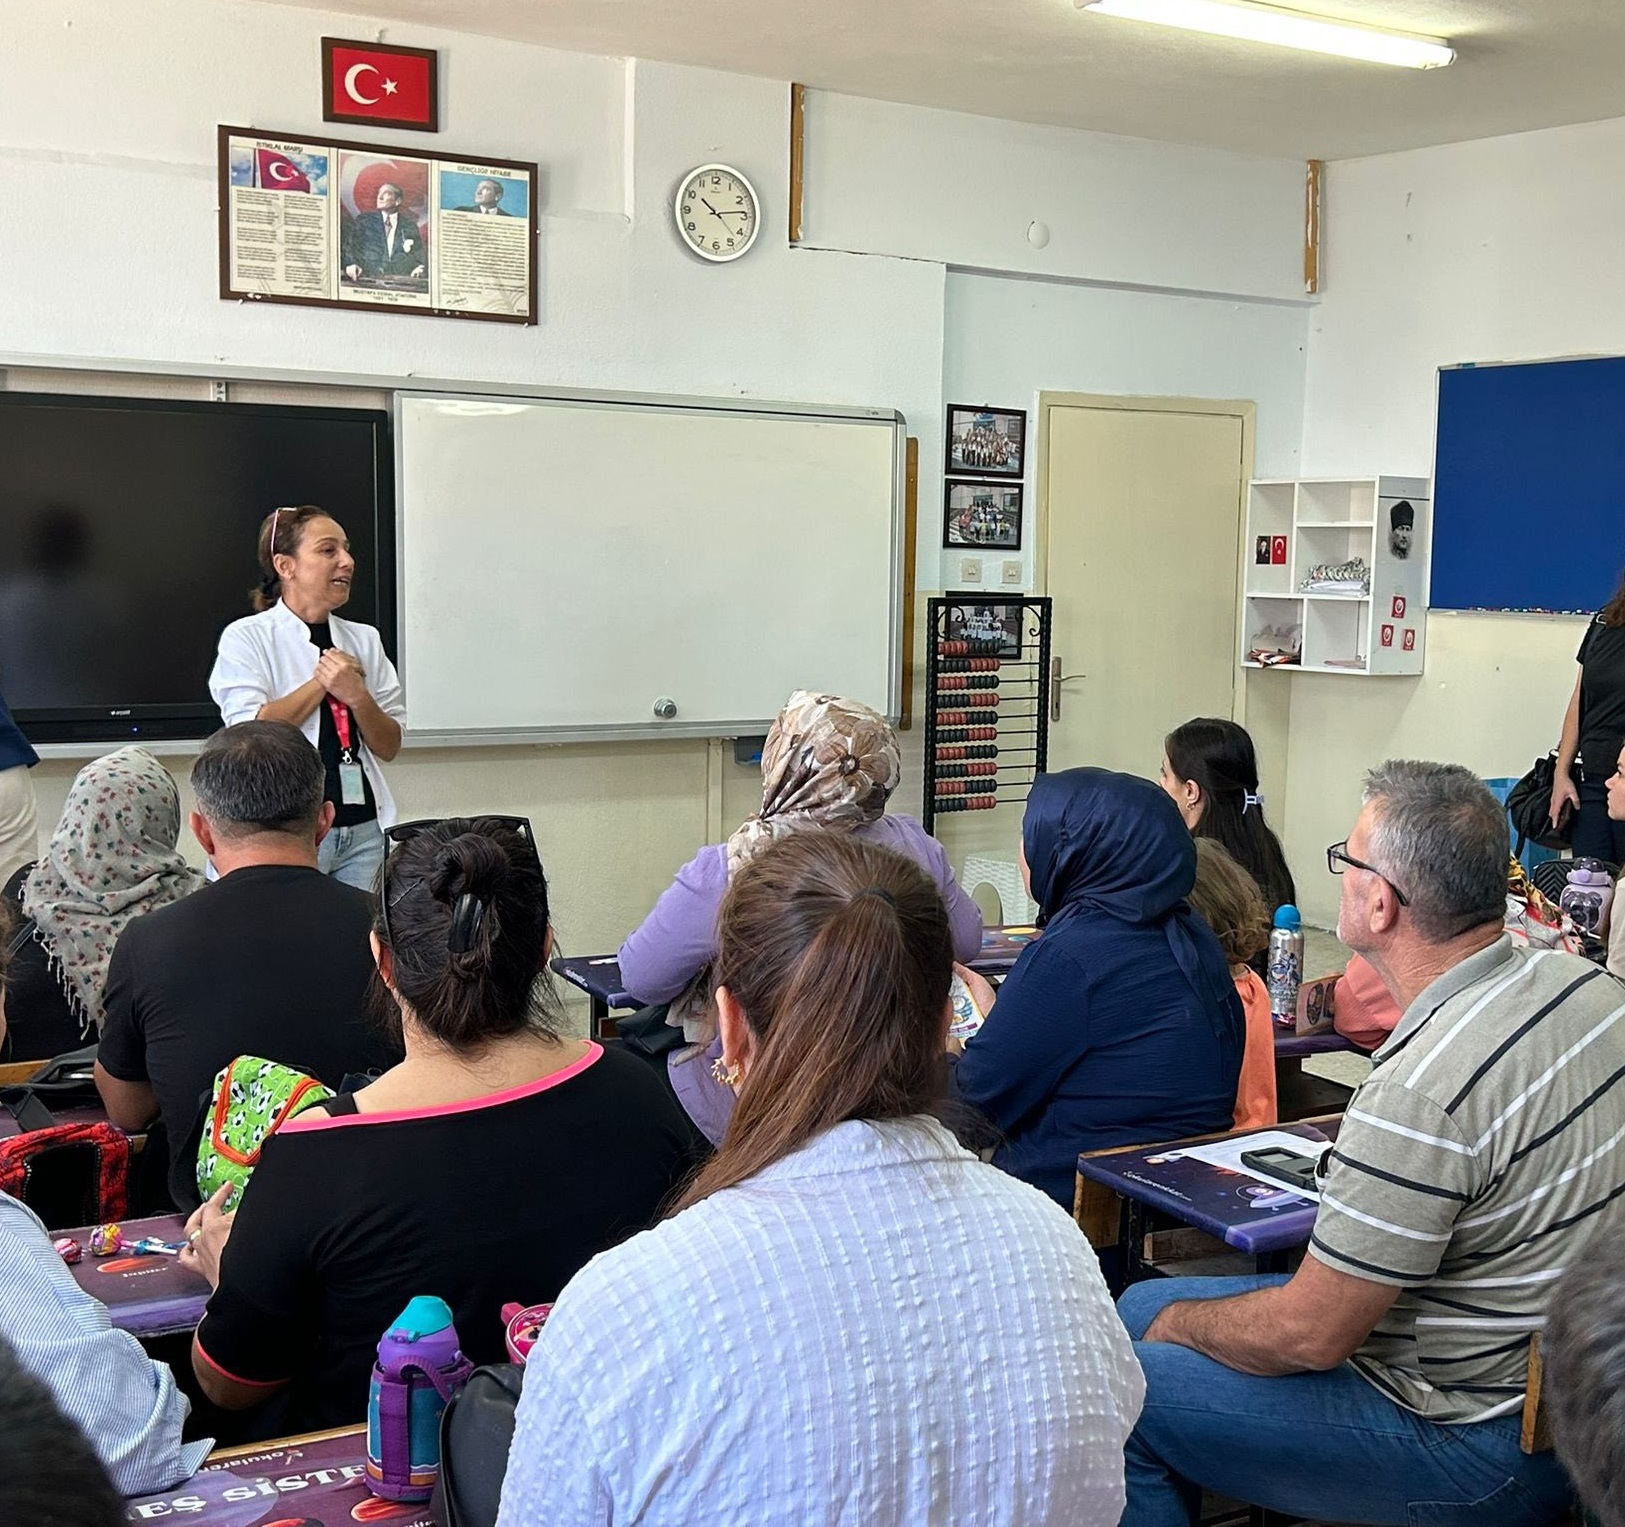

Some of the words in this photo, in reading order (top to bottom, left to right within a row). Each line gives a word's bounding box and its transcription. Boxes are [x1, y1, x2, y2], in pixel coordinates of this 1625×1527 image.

[699, 179, 705, 188] 11
[711, 176, 721, 185] 12
[688, 190, 697, 200] 10
[735, 195, 744, 205] 2
[683, 205, 691, 214] 9
[740, 211, 748, 221] 3
[687, 222, 696, 231] 8
[736, 227, 743, 236] 4
[698, 235, 705, 244] 7
[726, 237, 735, 247] 5
[712, 241, 720, 250] 6
[127, 1495, 207, 1520] EŞ
[222, 1465, 366, 1502] SİSTE
